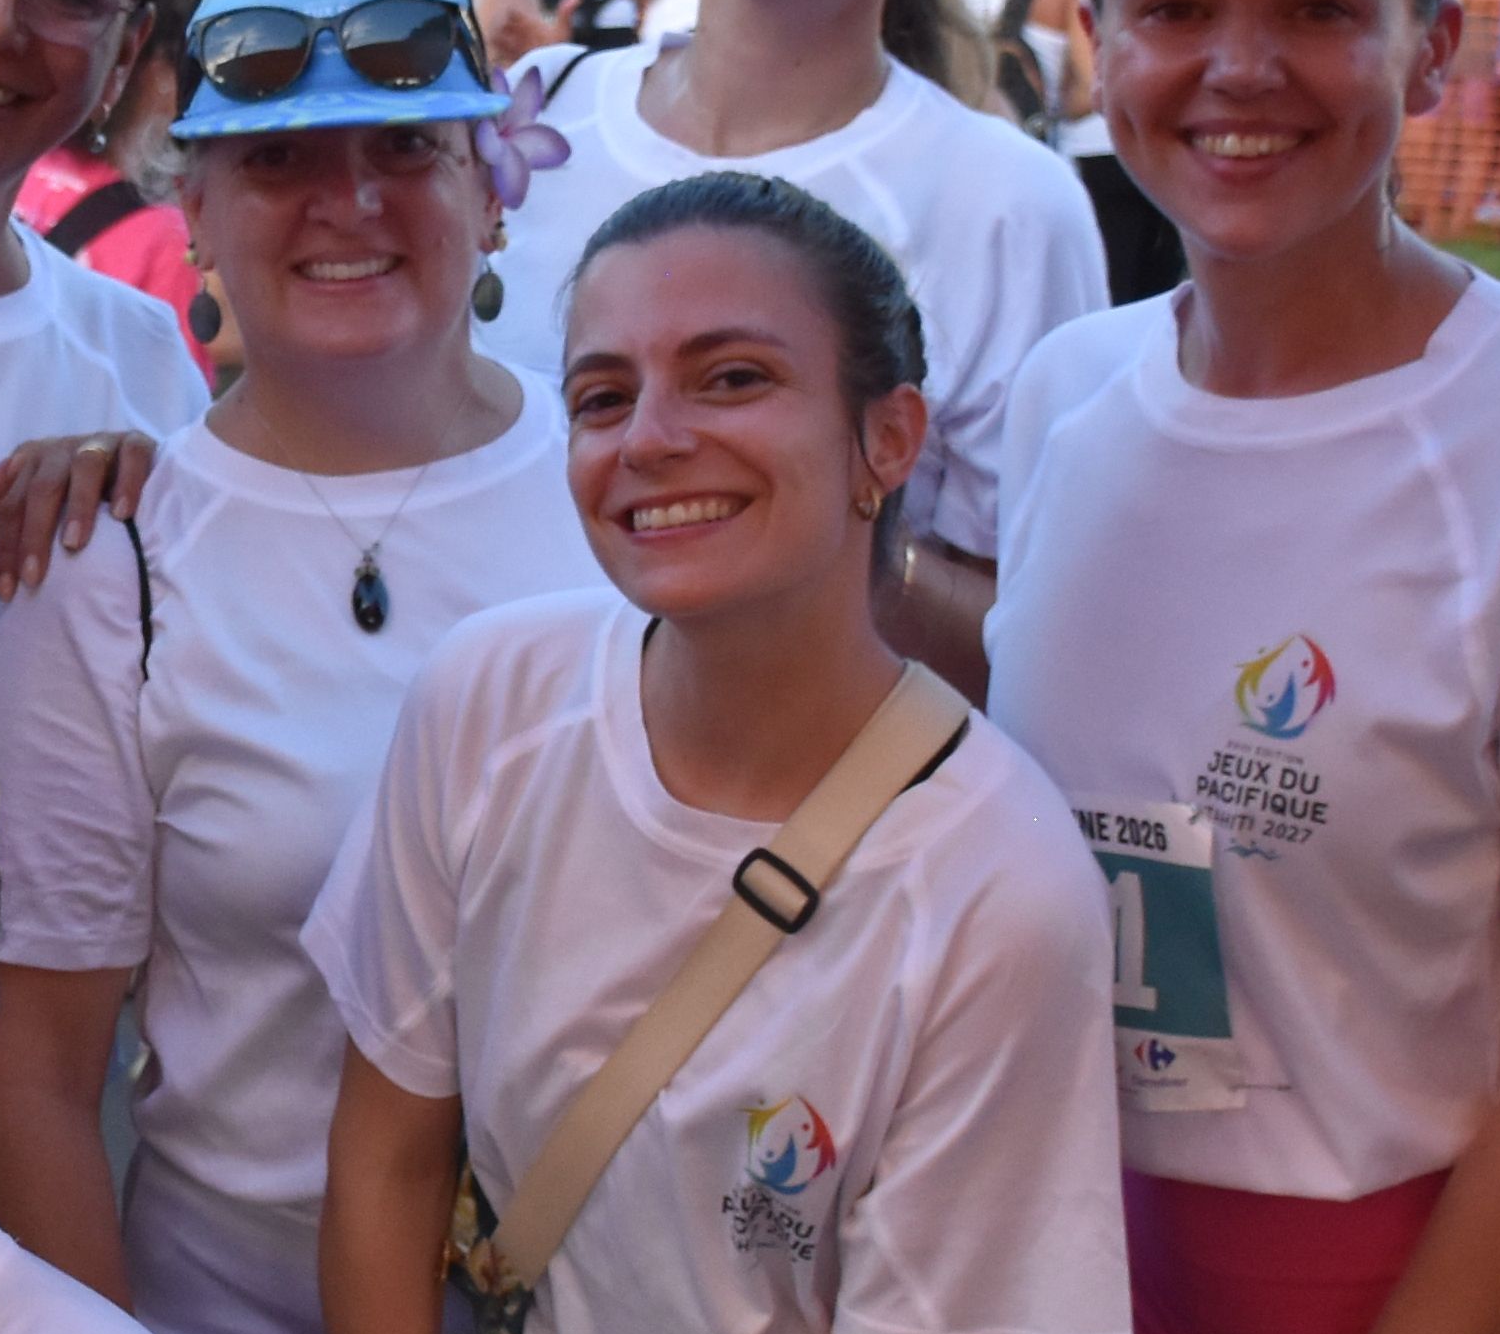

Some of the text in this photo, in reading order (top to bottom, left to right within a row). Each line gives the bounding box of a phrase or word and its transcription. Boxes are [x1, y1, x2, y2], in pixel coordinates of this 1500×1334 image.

[1207, 751, 1270, 785] JEUX
[1279, 768, 1320, 795] DU
[1196, 775, 1328, 825] PACIFIQUE
[1117, 816, 1168, 852] 2026
[1262, 820, 1312, 844] 2027
